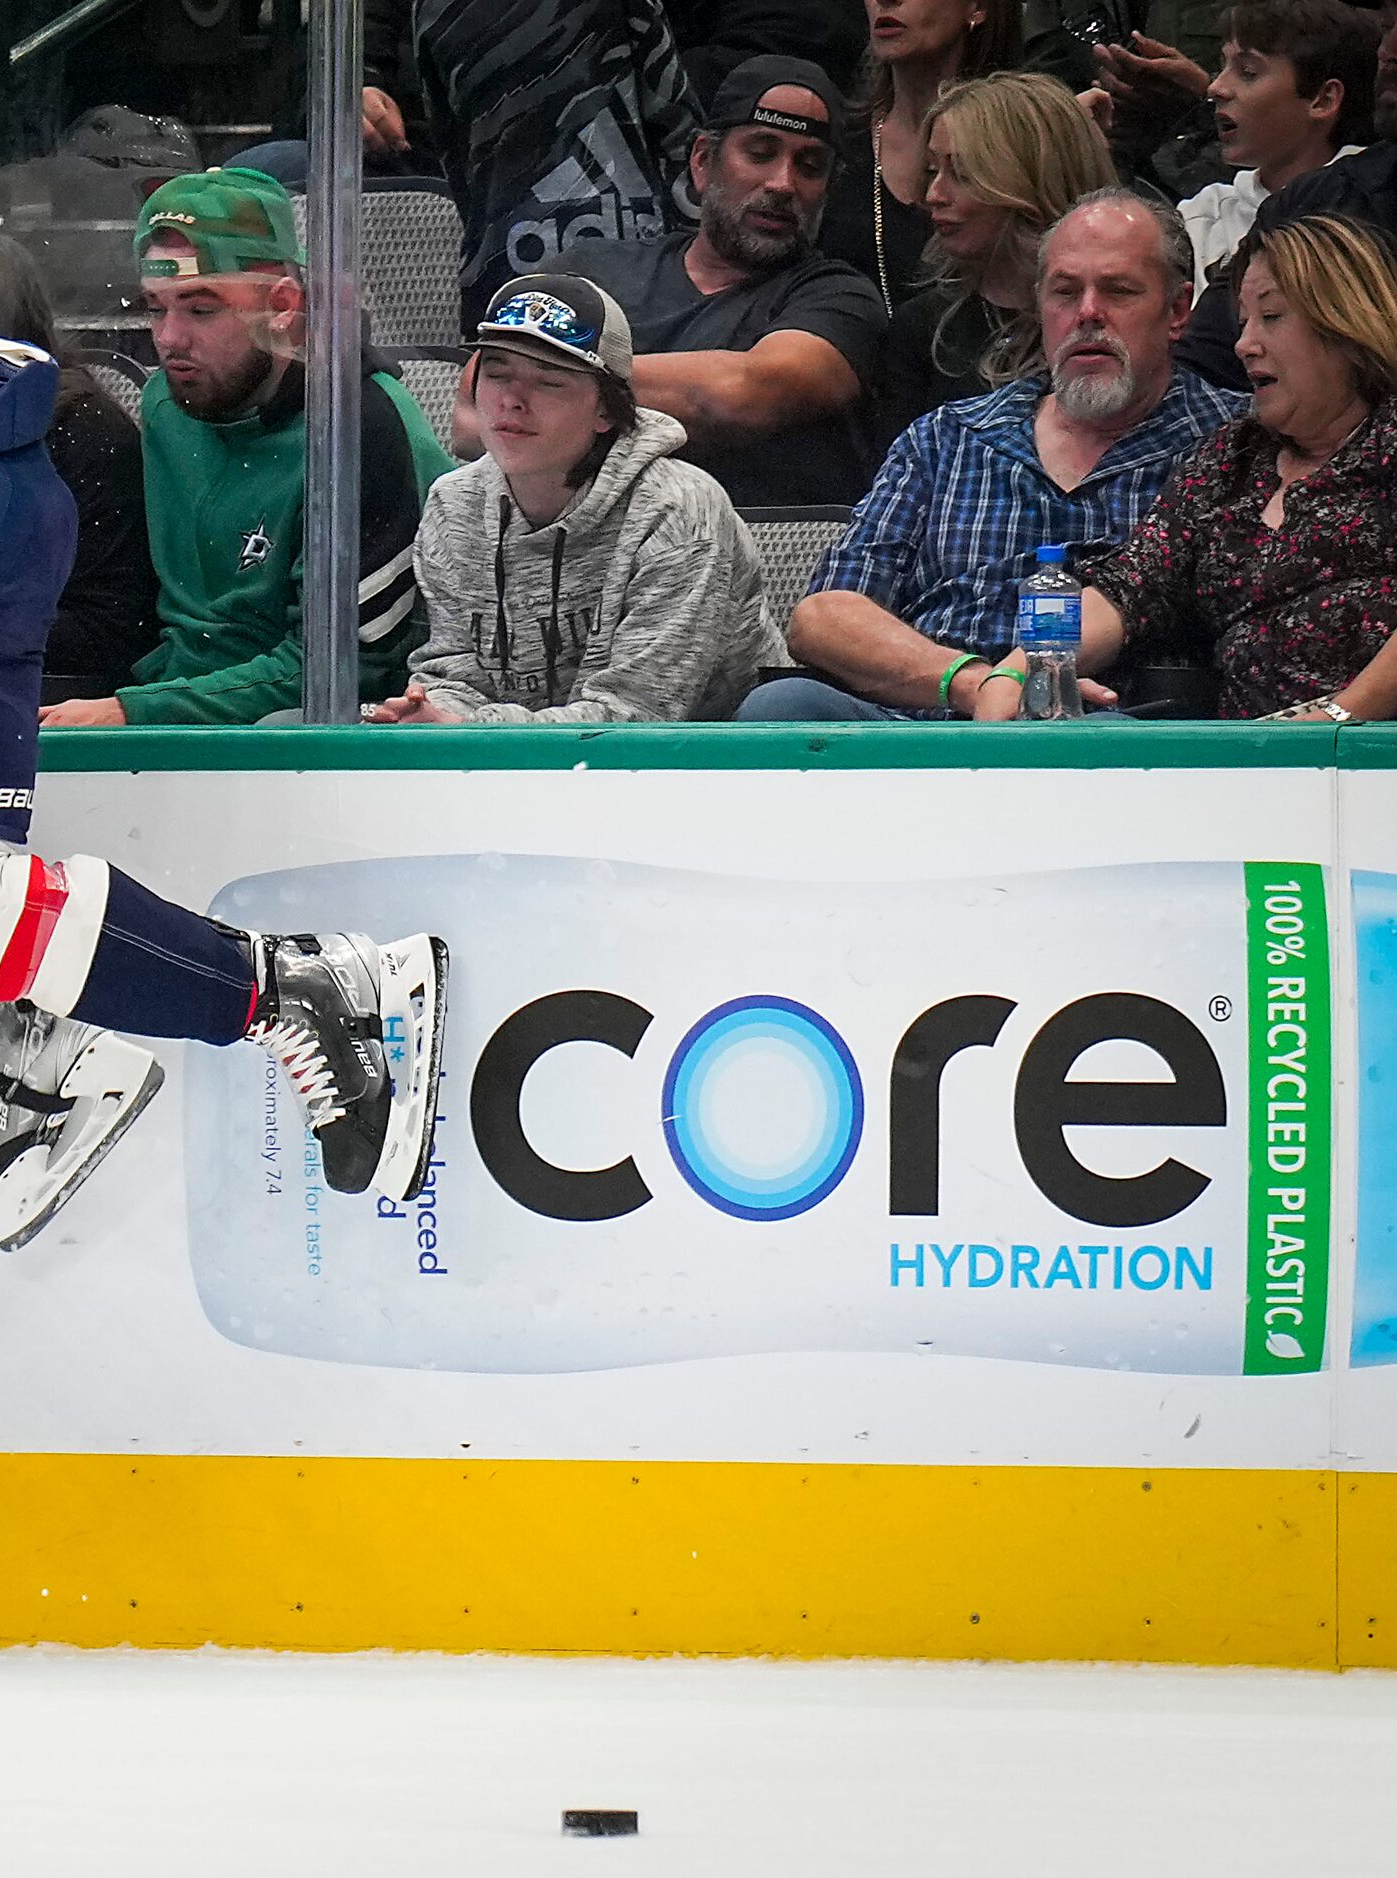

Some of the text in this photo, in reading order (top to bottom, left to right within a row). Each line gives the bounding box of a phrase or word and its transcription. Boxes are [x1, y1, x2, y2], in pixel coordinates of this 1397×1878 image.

[753, 108, 808, 131] lululemon
[360, 703, 376, 717] 85
[1263, 879, 1306, 1327] 100% RECYCLED PLASTIC
[265, 1170, 282, 1195] 7.4
[305, 1185, 324, 1216] for
[417, 1115, 448, 1274] lanced
[305, 1223, 322, 1276] taste
[890, 1243, 1213, 1290] HYDRATION
